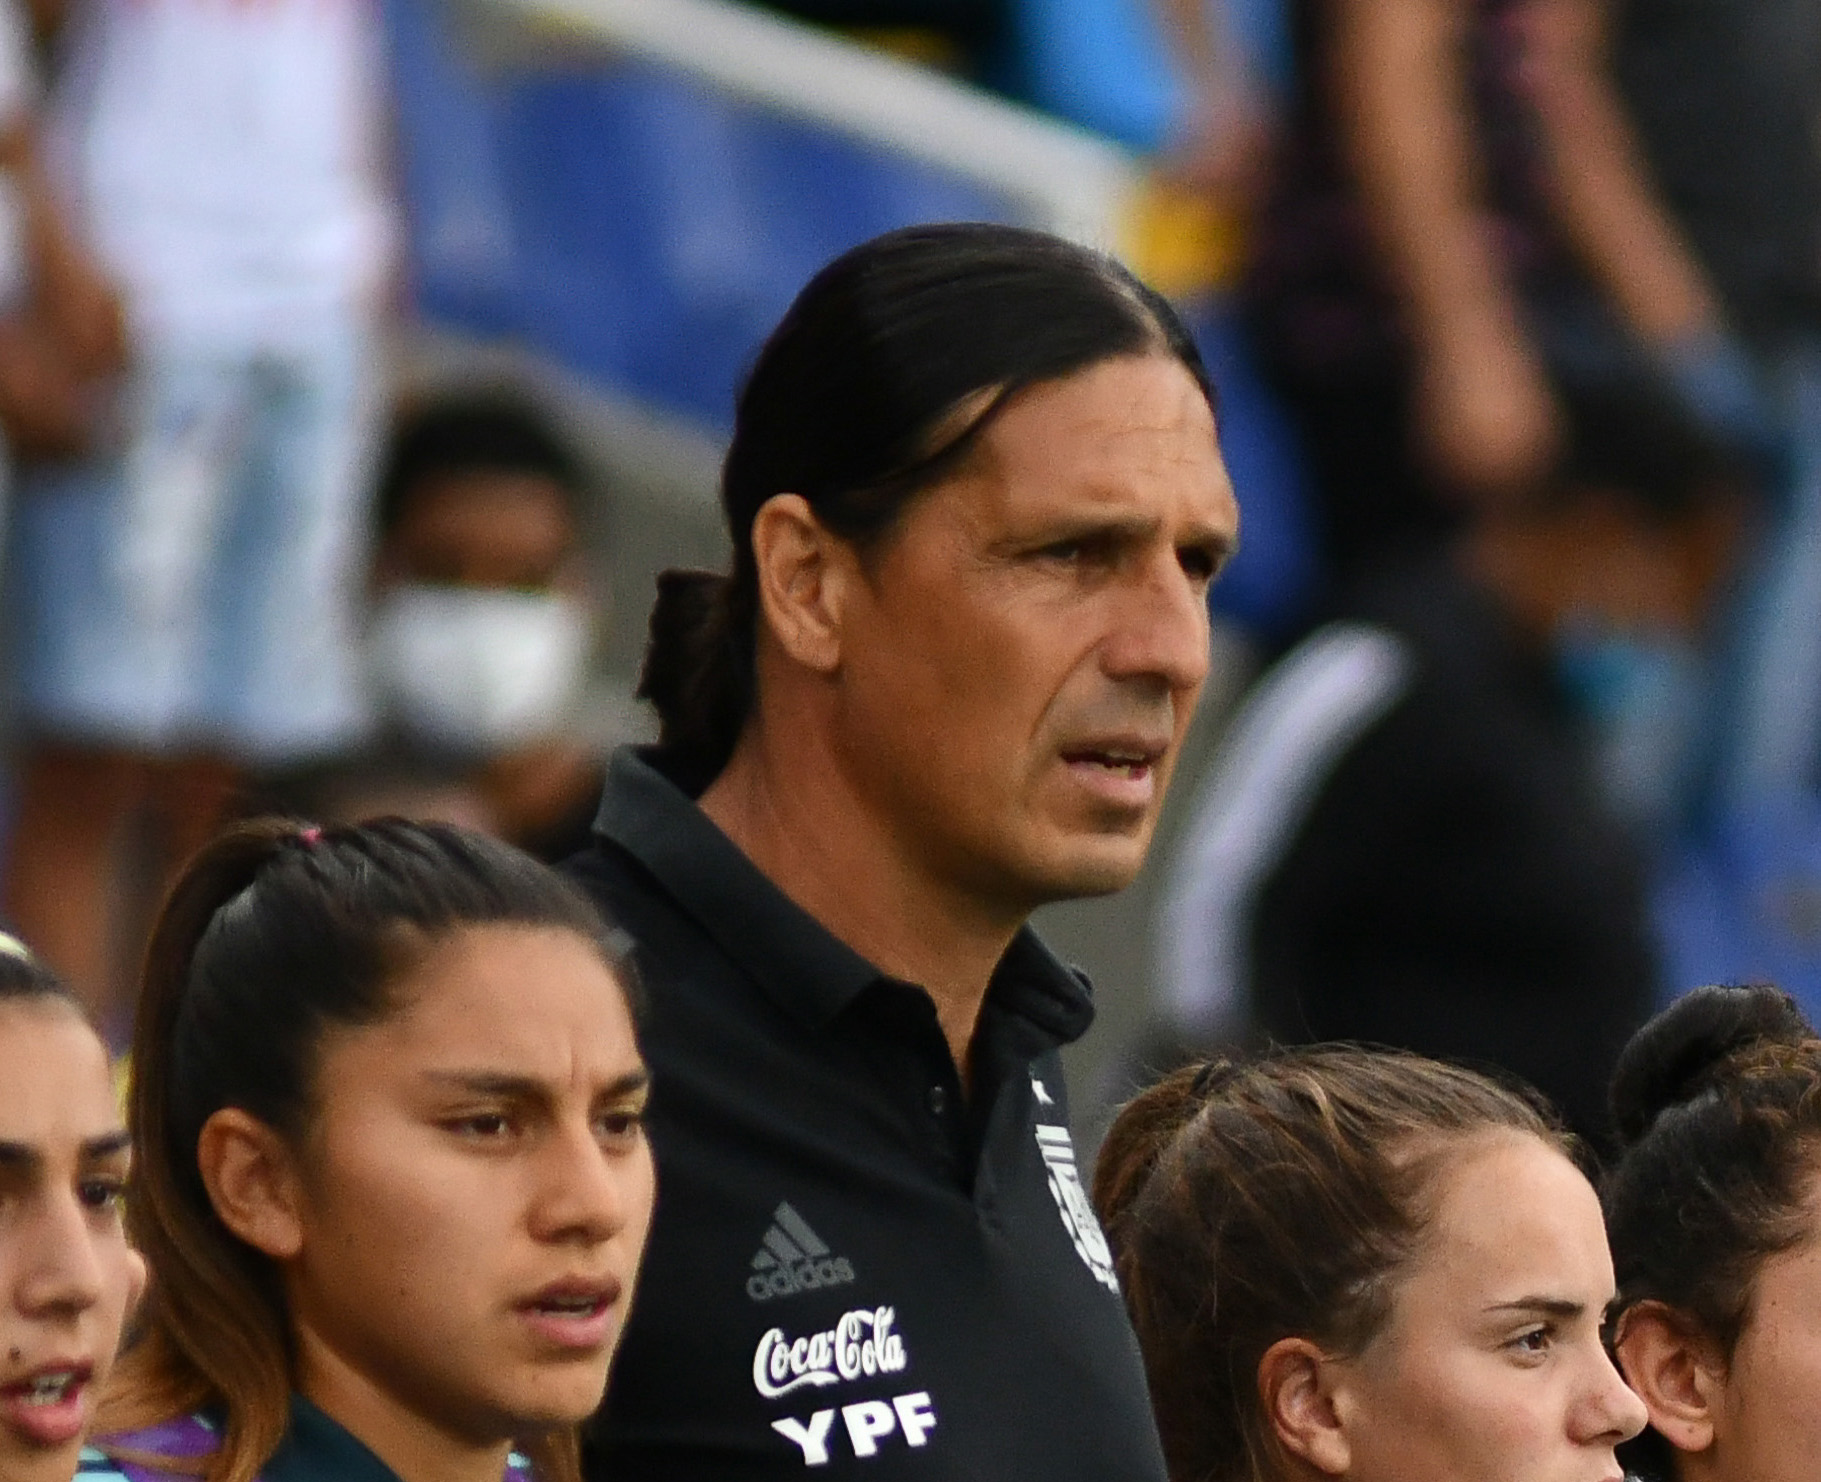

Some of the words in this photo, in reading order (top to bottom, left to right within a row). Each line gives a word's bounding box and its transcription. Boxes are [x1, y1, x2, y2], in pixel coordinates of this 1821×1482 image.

[746, 1256, 855, 1300] adidas
[753, 1306, 907, 1398] Coca-Cola
[770, 1391, 937, 1466] YPF
